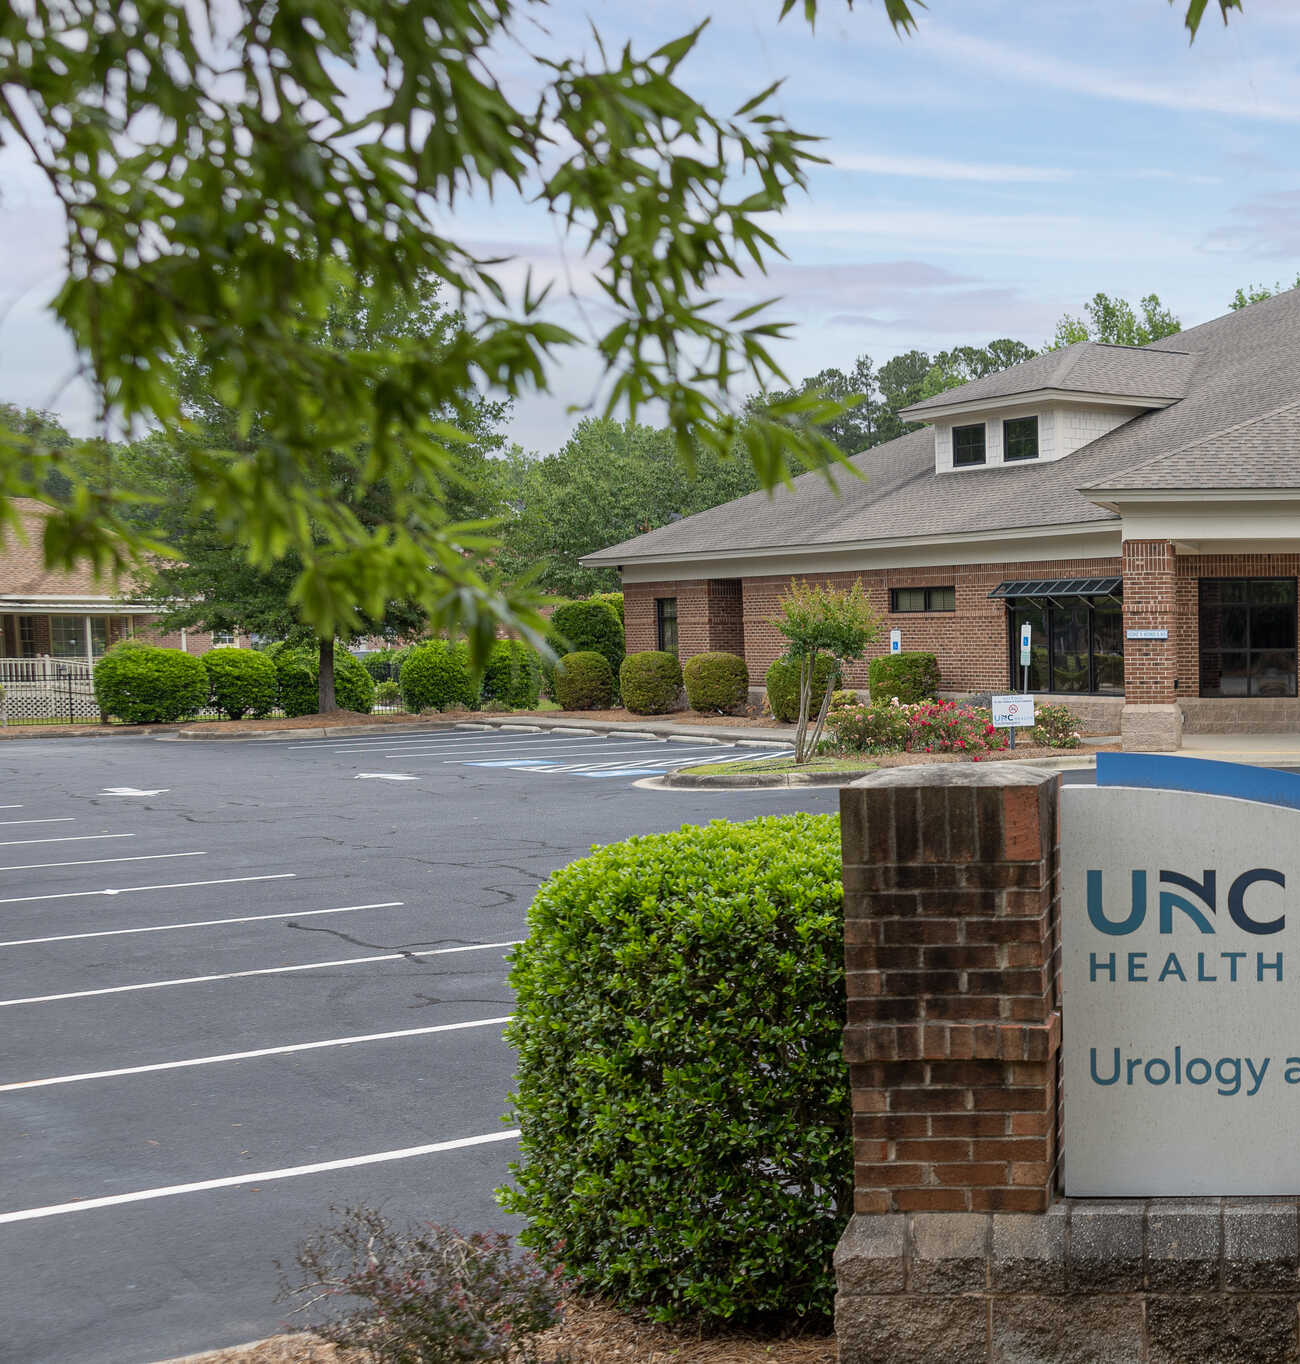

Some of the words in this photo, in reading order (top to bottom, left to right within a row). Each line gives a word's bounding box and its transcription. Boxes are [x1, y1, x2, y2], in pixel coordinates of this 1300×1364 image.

[1086, 868, 1286, 935] UNC
[1089, 952, 1284, 982] HEALTH
[1089, 1046, 1270, 1096] Urology
